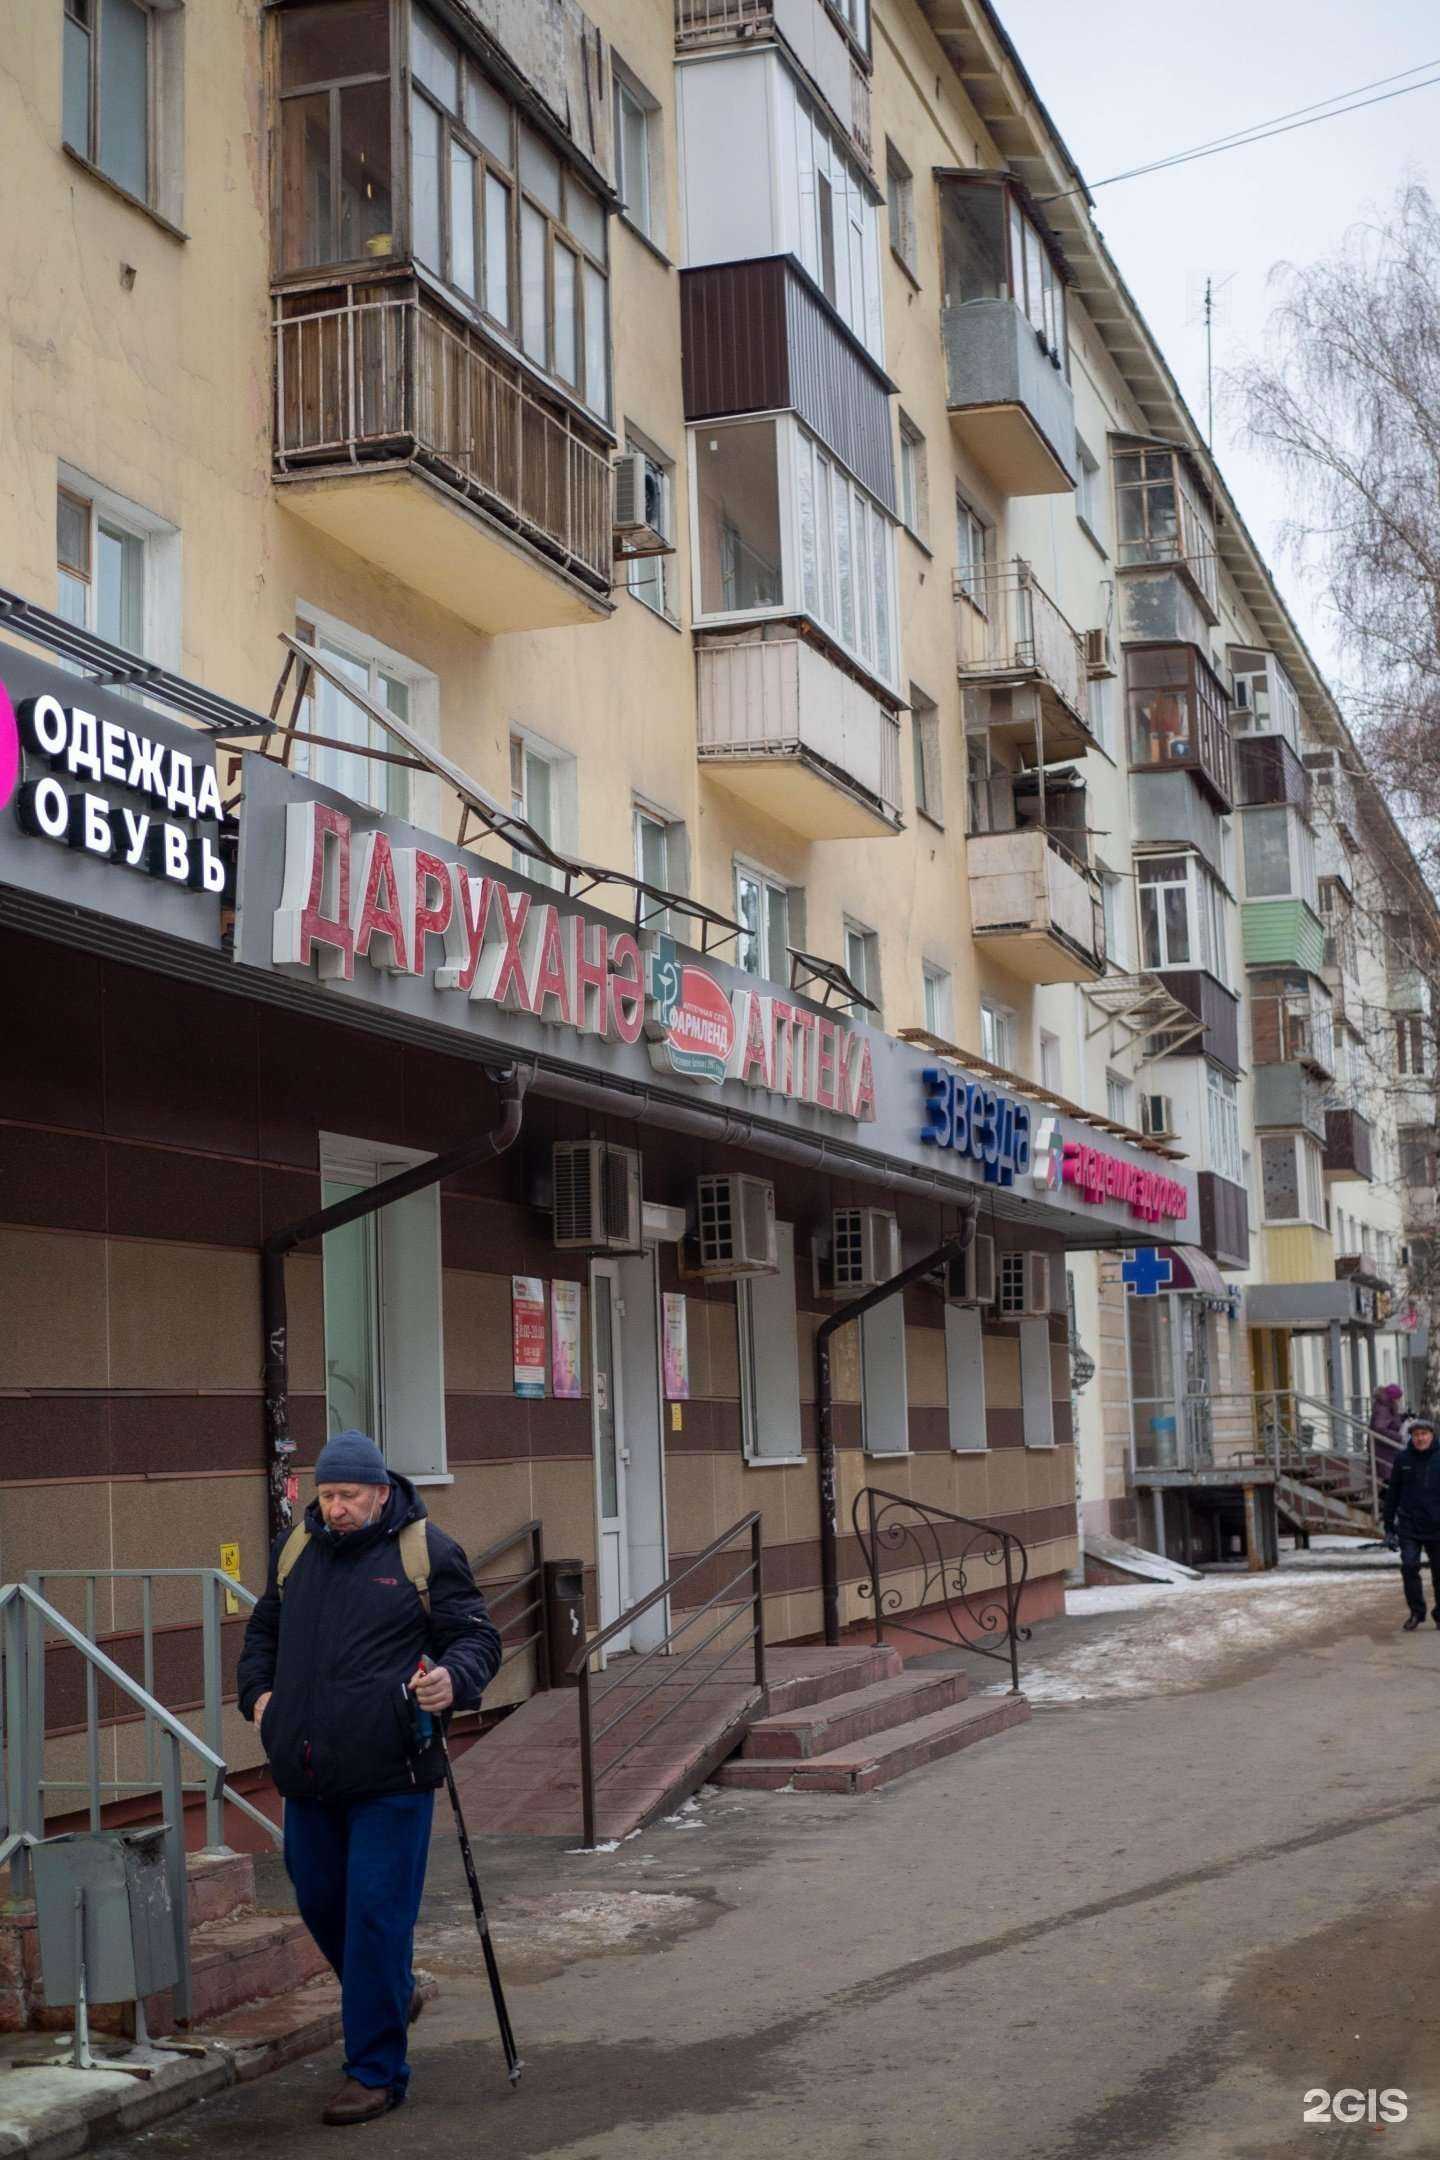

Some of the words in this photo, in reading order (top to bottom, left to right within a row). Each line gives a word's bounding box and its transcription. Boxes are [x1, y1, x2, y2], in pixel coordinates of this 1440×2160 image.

[34, 694, 225, 822] ОДЕЖДА
[34, 777, 226, 893] ОБУВЬ
[298, 801, 644, 1044] ДАРУХАНӘ
[742, 990, 877, 1123] АПТЕКА
[668, 1005, 728, 1051] ФАРМЛЕНД
